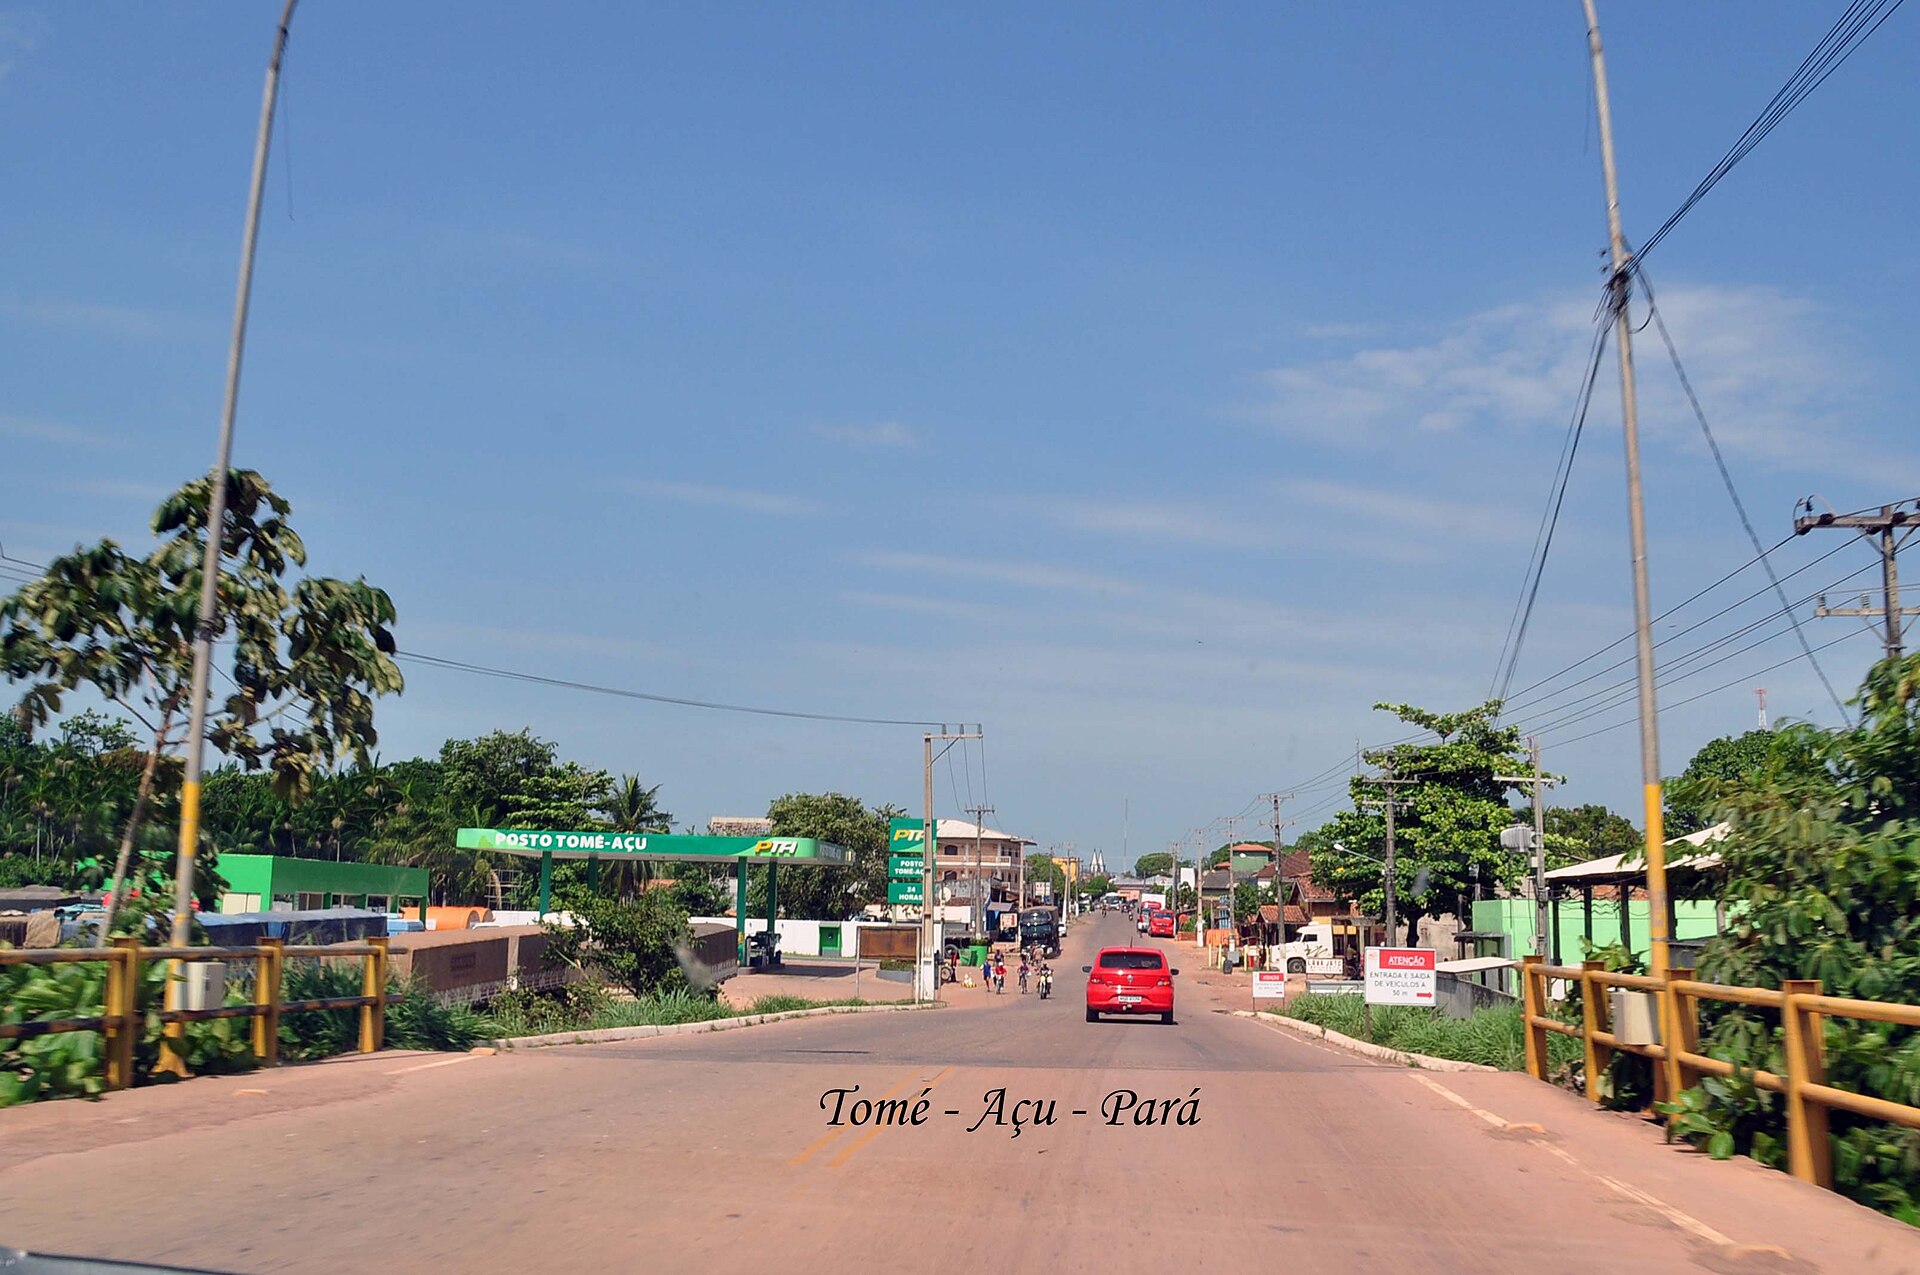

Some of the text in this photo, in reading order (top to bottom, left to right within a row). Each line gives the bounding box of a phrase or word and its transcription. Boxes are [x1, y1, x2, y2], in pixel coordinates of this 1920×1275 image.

[495, 833, 647, 853] POSTO TOMÉ-AÇU
[1387, 955, 1426, 967] ATENÇÃO
[1374, 980, 1383, 988] DE
